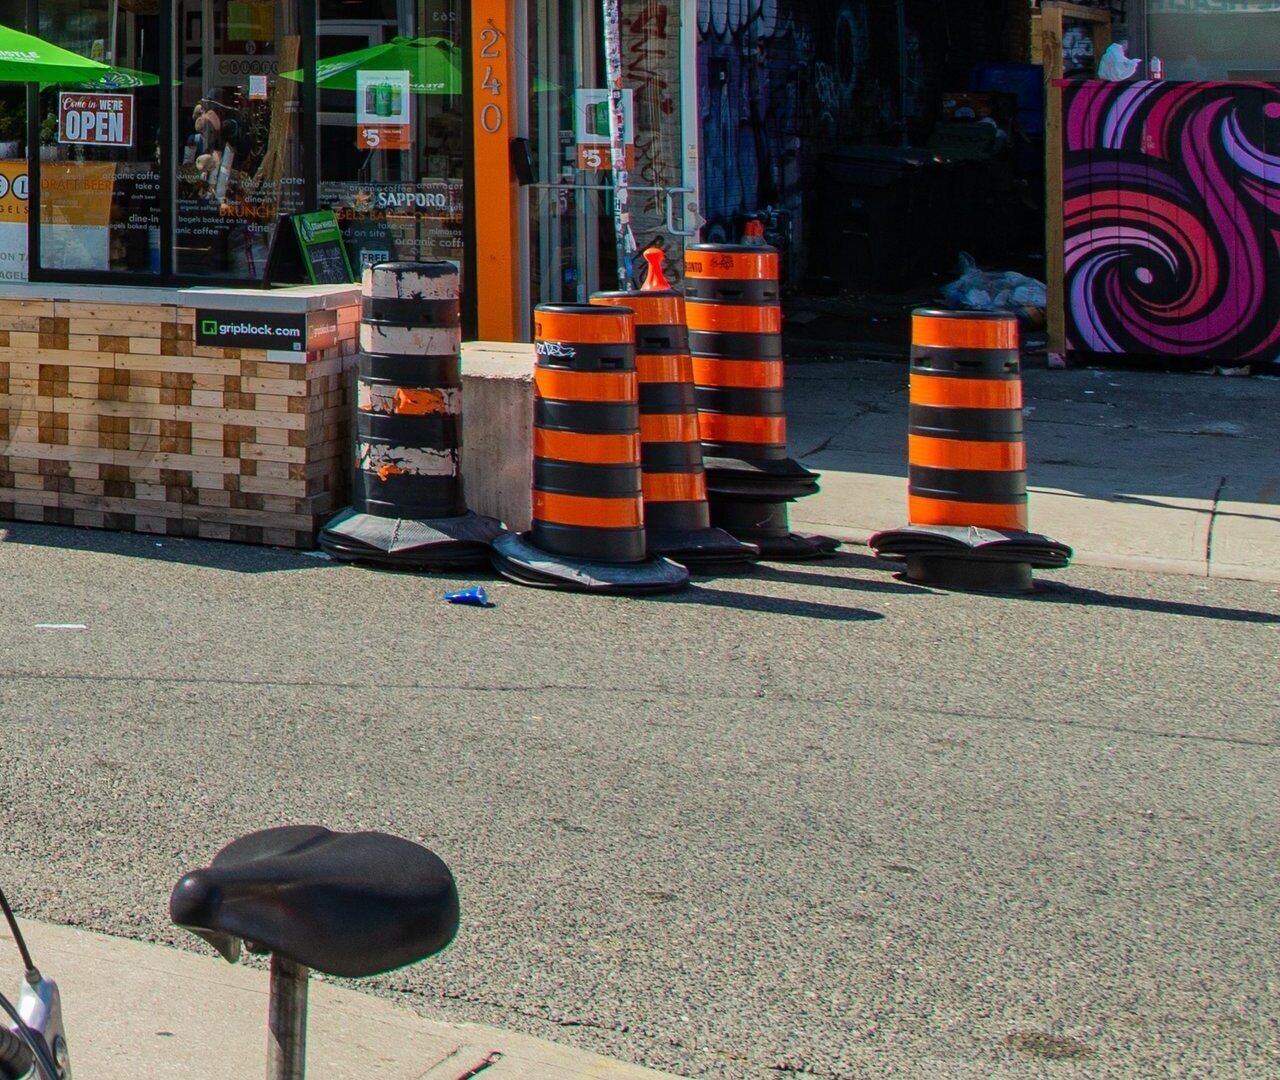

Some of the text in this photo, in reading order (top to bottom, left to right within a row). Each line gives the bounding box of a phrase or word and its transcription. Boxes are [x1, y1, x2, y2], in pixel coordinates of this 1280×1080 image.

[478, 26, 504, 136] 240
[62, 97, 124, 111] Come in WE'RE
[65, 111, 125, 142] OPEN
[378, 192, 446, 208] SAPPORO
[128, 214, 159, 223] dine-in
[219, 206, 277, 218] BRUNCH
[0, 252, 15, 261] ON
[361, 253, 388, 262] FREE
[219, 322, 301, 338] gripblock.com
